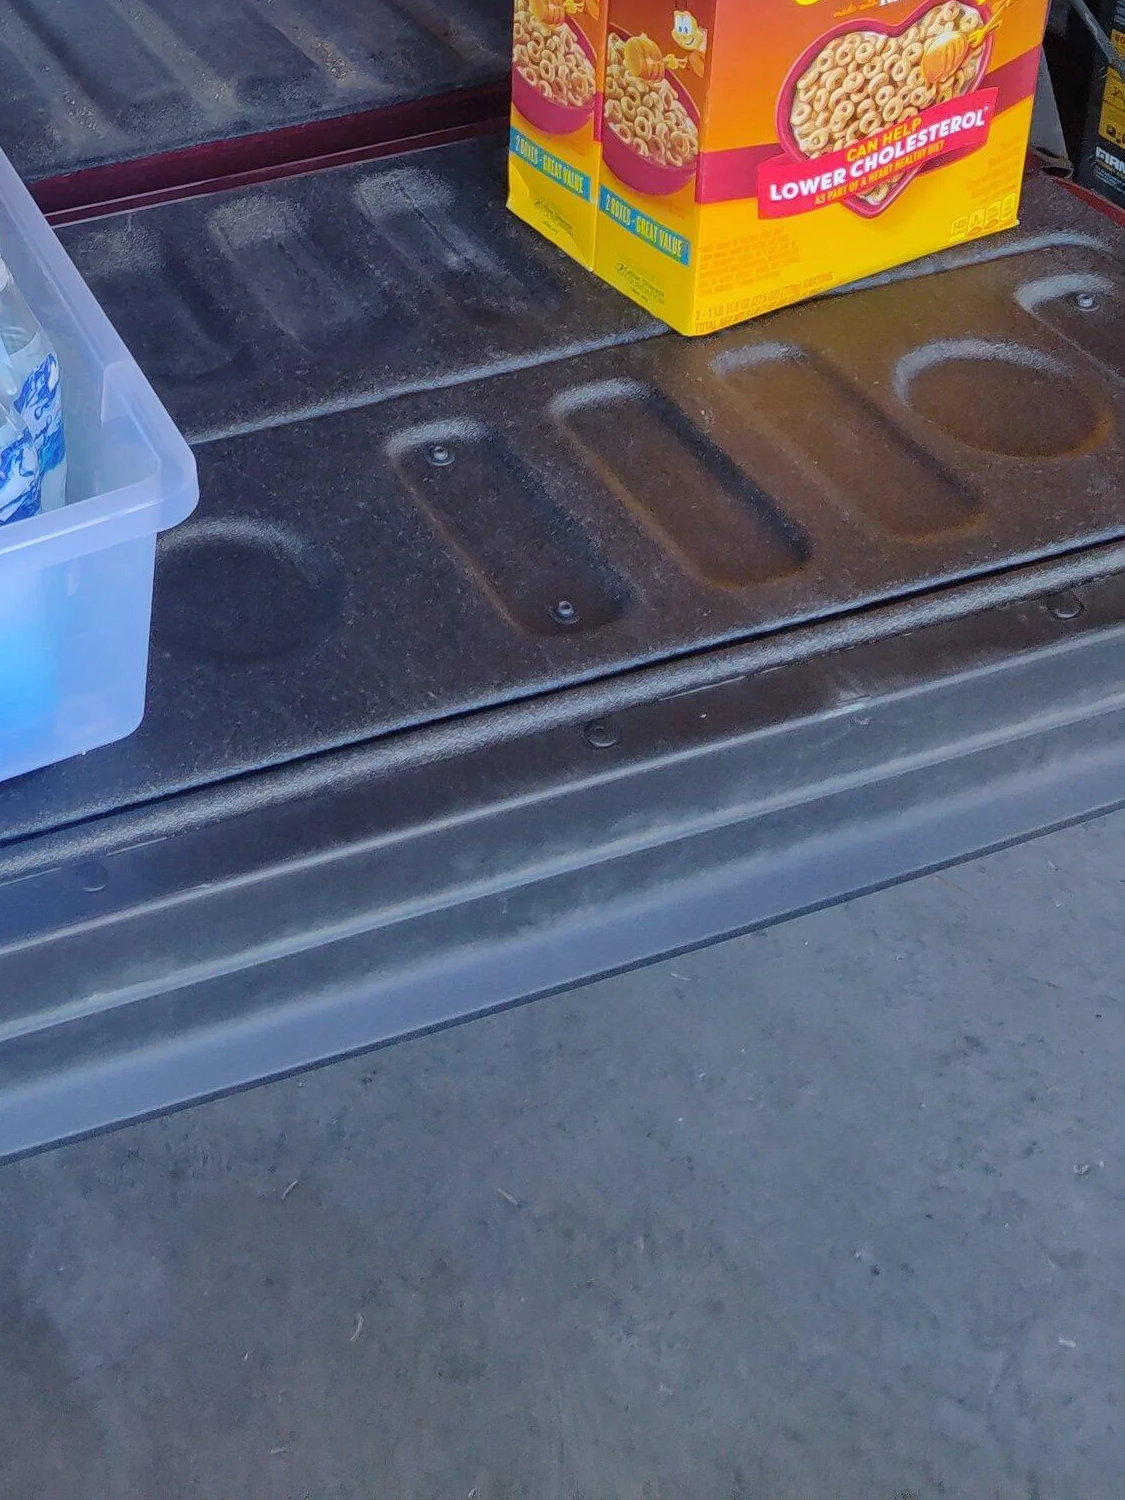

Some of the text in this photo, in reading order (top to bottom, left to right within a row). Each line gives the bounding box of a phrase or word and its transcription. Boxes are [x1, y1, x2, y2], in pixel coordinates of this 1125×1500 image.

[515, 135, 521, 148] 2
[543, 154, 563, 180] GREAT
[562, 165, 584, 195] VALUE
[770, 167, 846, 201] LOWER
[850, 109, 987, 178] CHOLESTEROL
[847, 117, 922, 161] CAN HELP
[815, 139, 945, 206] AS PART OF A HEART HEALTHY DIET
[605, 193, 611, 211] 2
[609, 196, 632, 226] BOXES
[636, 215, 659, 243] GREAT
[659, 227, 683, 258] VALUE
